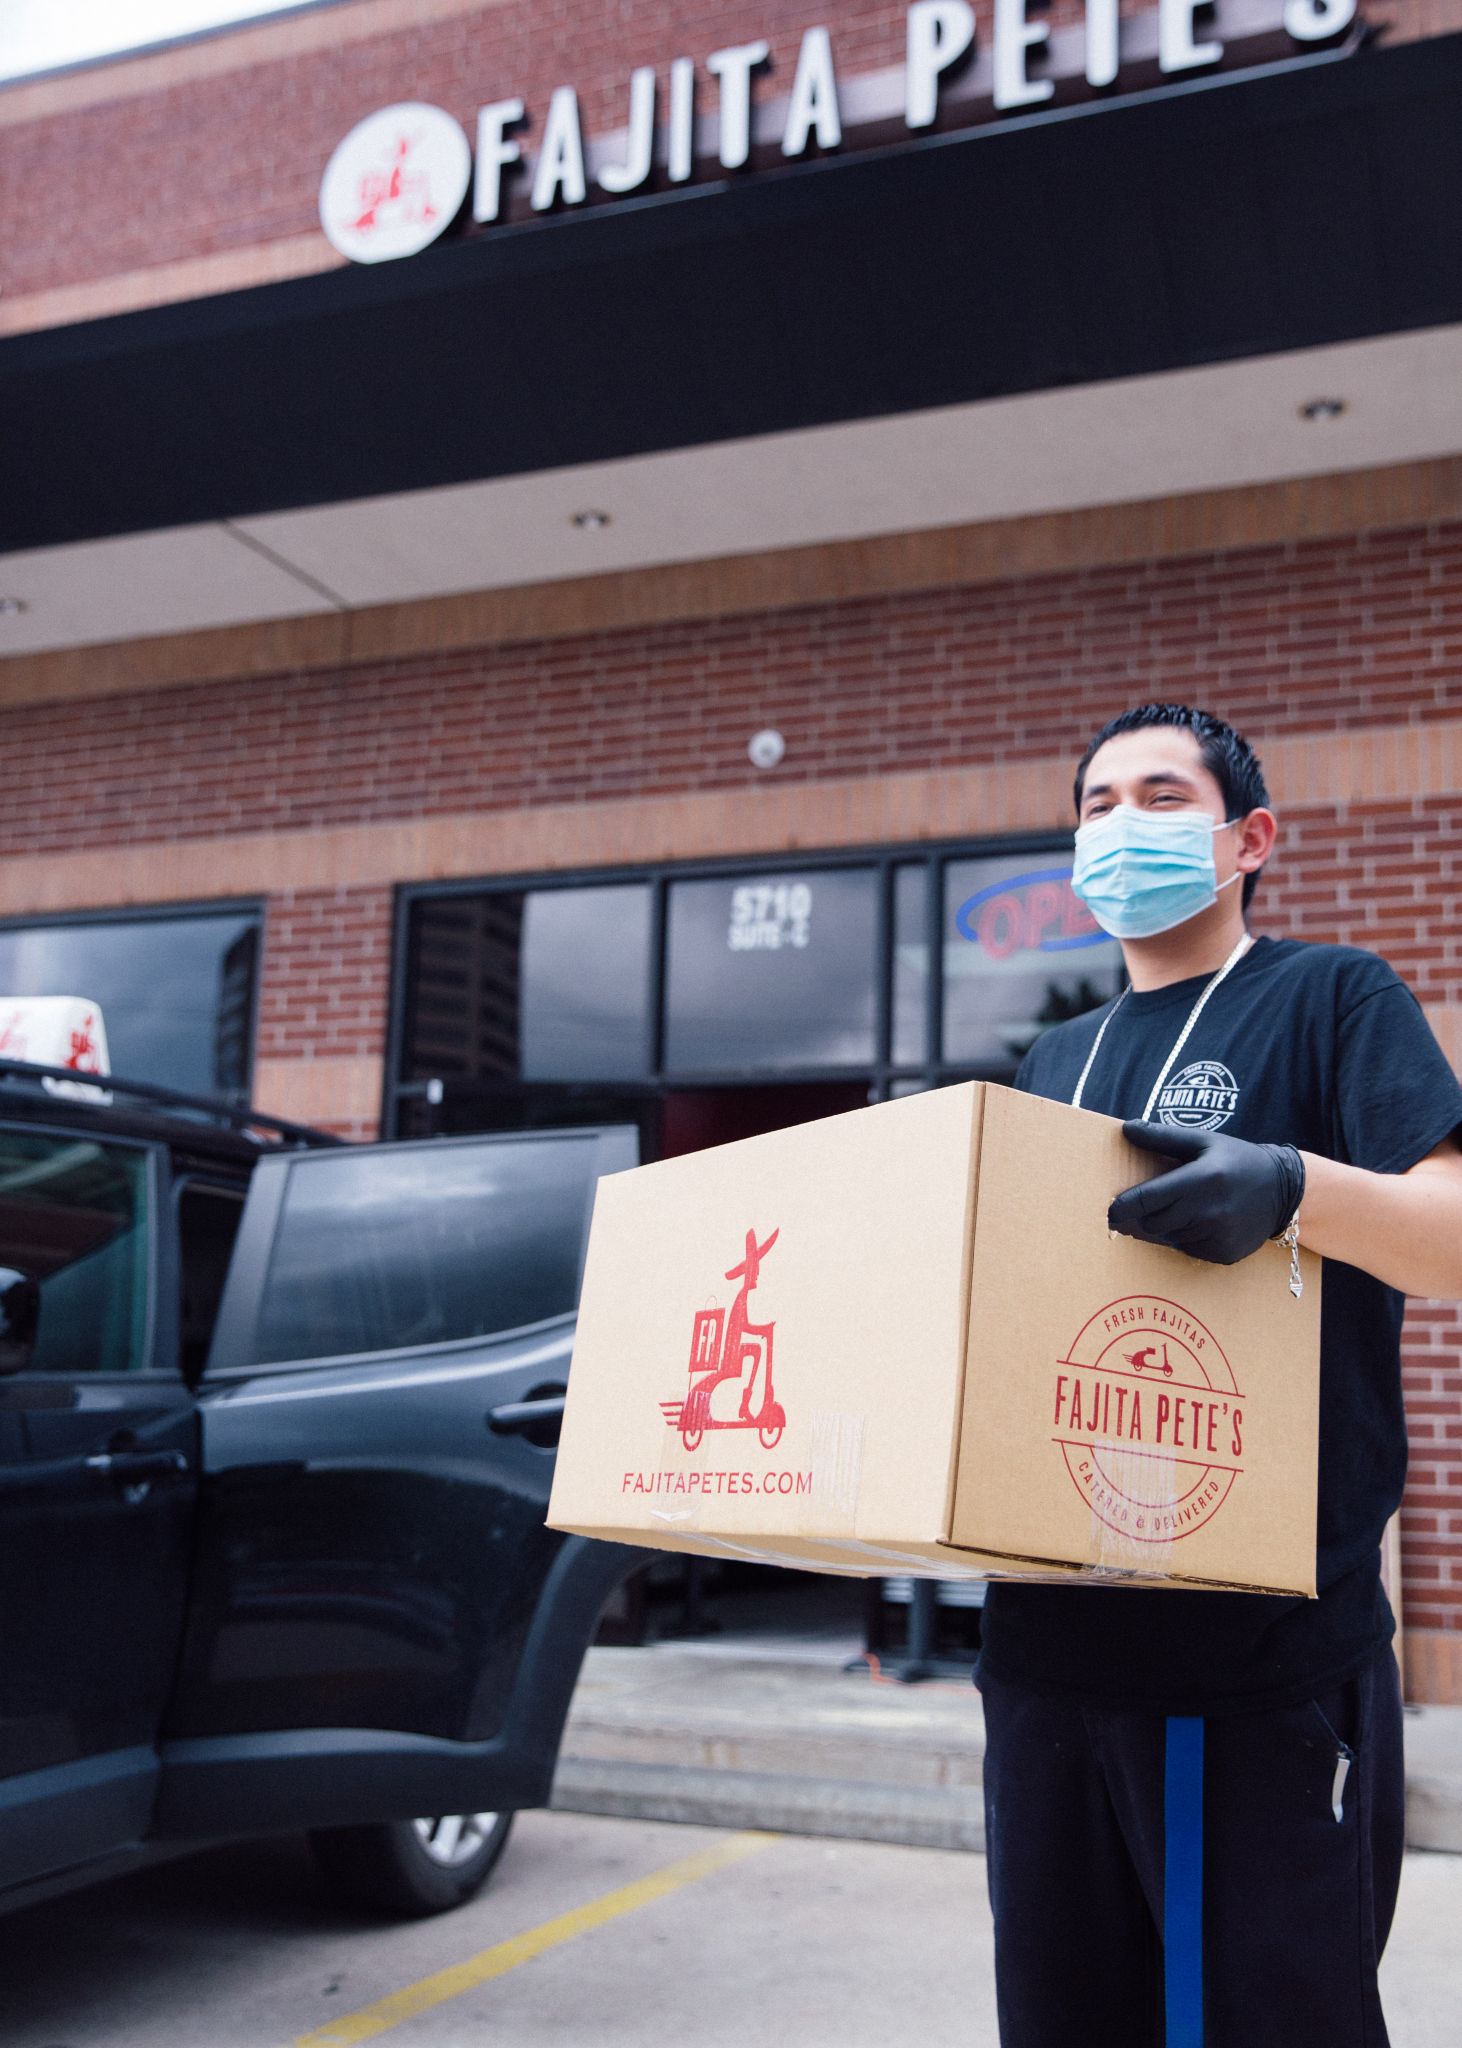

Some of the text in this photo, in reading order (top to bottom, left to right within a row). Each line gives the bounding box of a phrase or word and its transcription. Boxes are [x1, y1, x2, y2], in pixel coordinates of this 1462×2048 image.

[473, 26, 842, 223] FAJITA
[979, 877, 1099, 961] OPE
[1158, 1089, 1238, 1110] FAJITA PETE'S
[696, 1319, 717, 1363] FP
[1104, 1307, 1206, 1349] FRESH FAJITAS
[1054, 1375, 1243, 1456] FAJITA PETE'S
[622, 1472, 813, 1494] FAJITAPETES.COM
[1078, 1461, 1128, 1521] CATERED
[1154, 1481, 1219, 1530] DELIVERED
